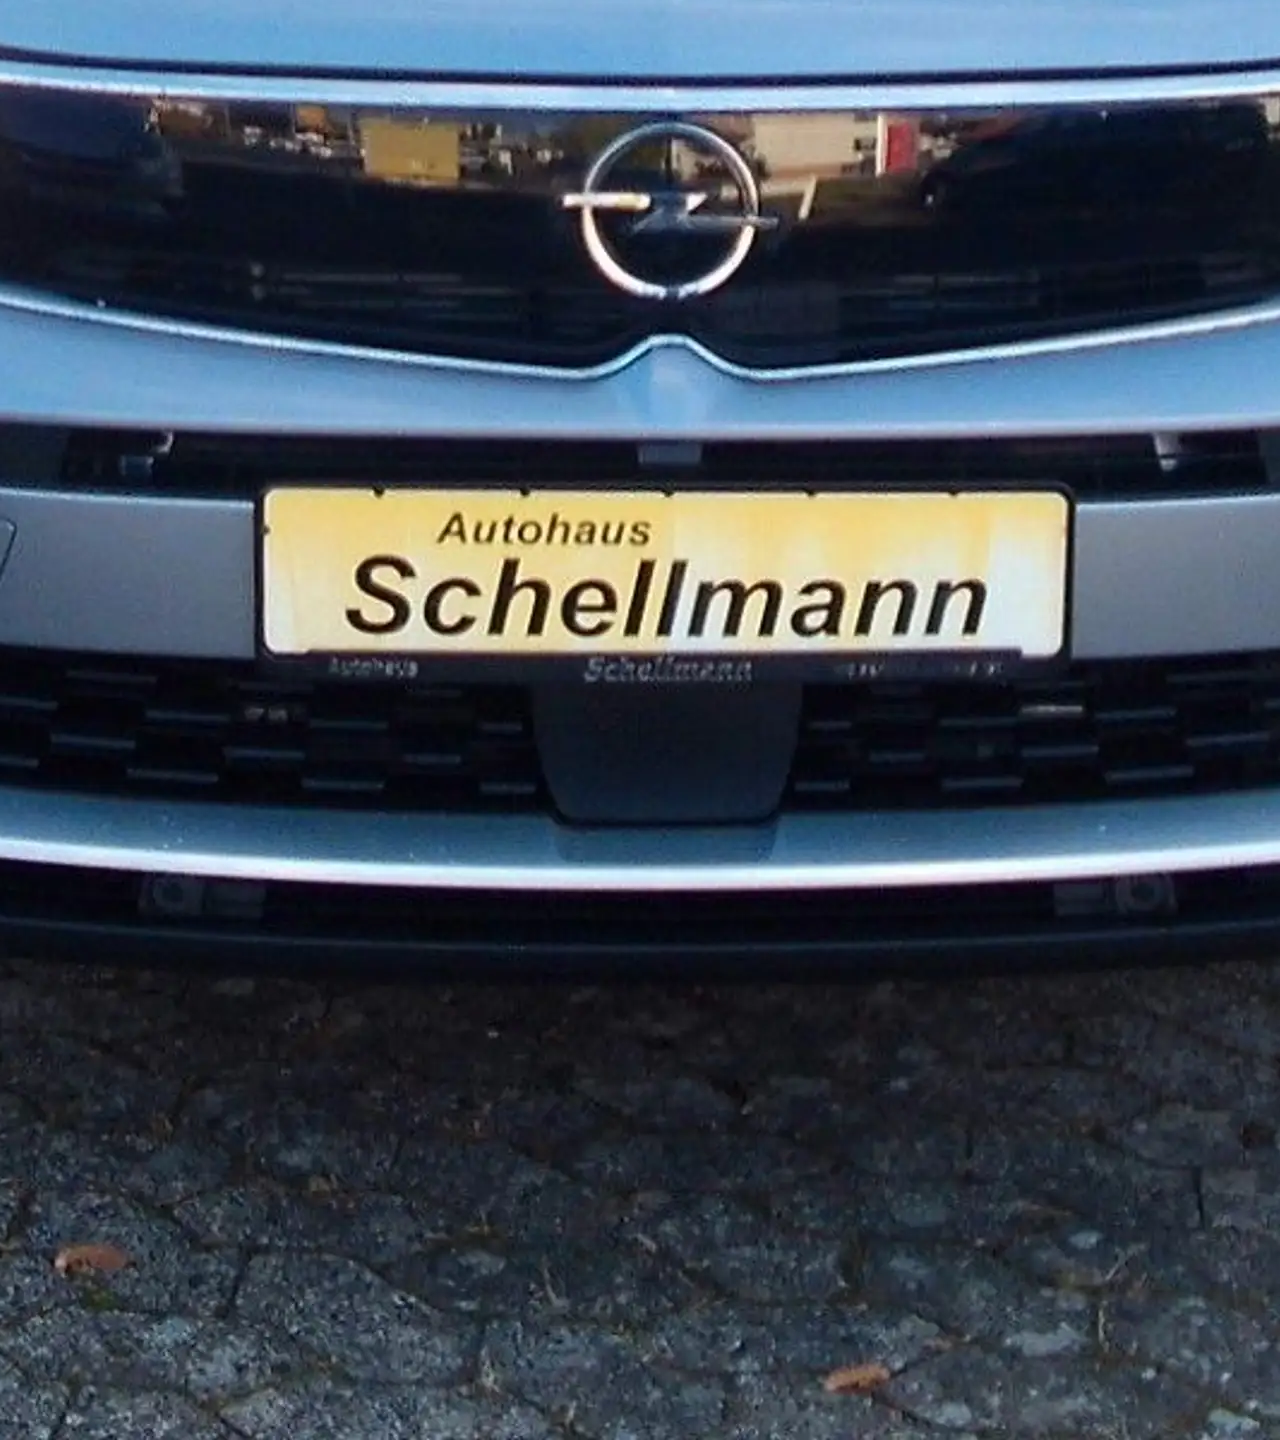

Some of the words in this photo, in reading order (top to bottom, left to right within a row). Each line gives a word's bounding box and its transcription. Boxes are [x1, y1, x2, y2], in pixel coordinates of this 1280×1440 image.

[437, 512, 650, 546] Autohaus
[344, 555, 988, 638] Schellmann
[582, 655, 754, 682] Schellmann
